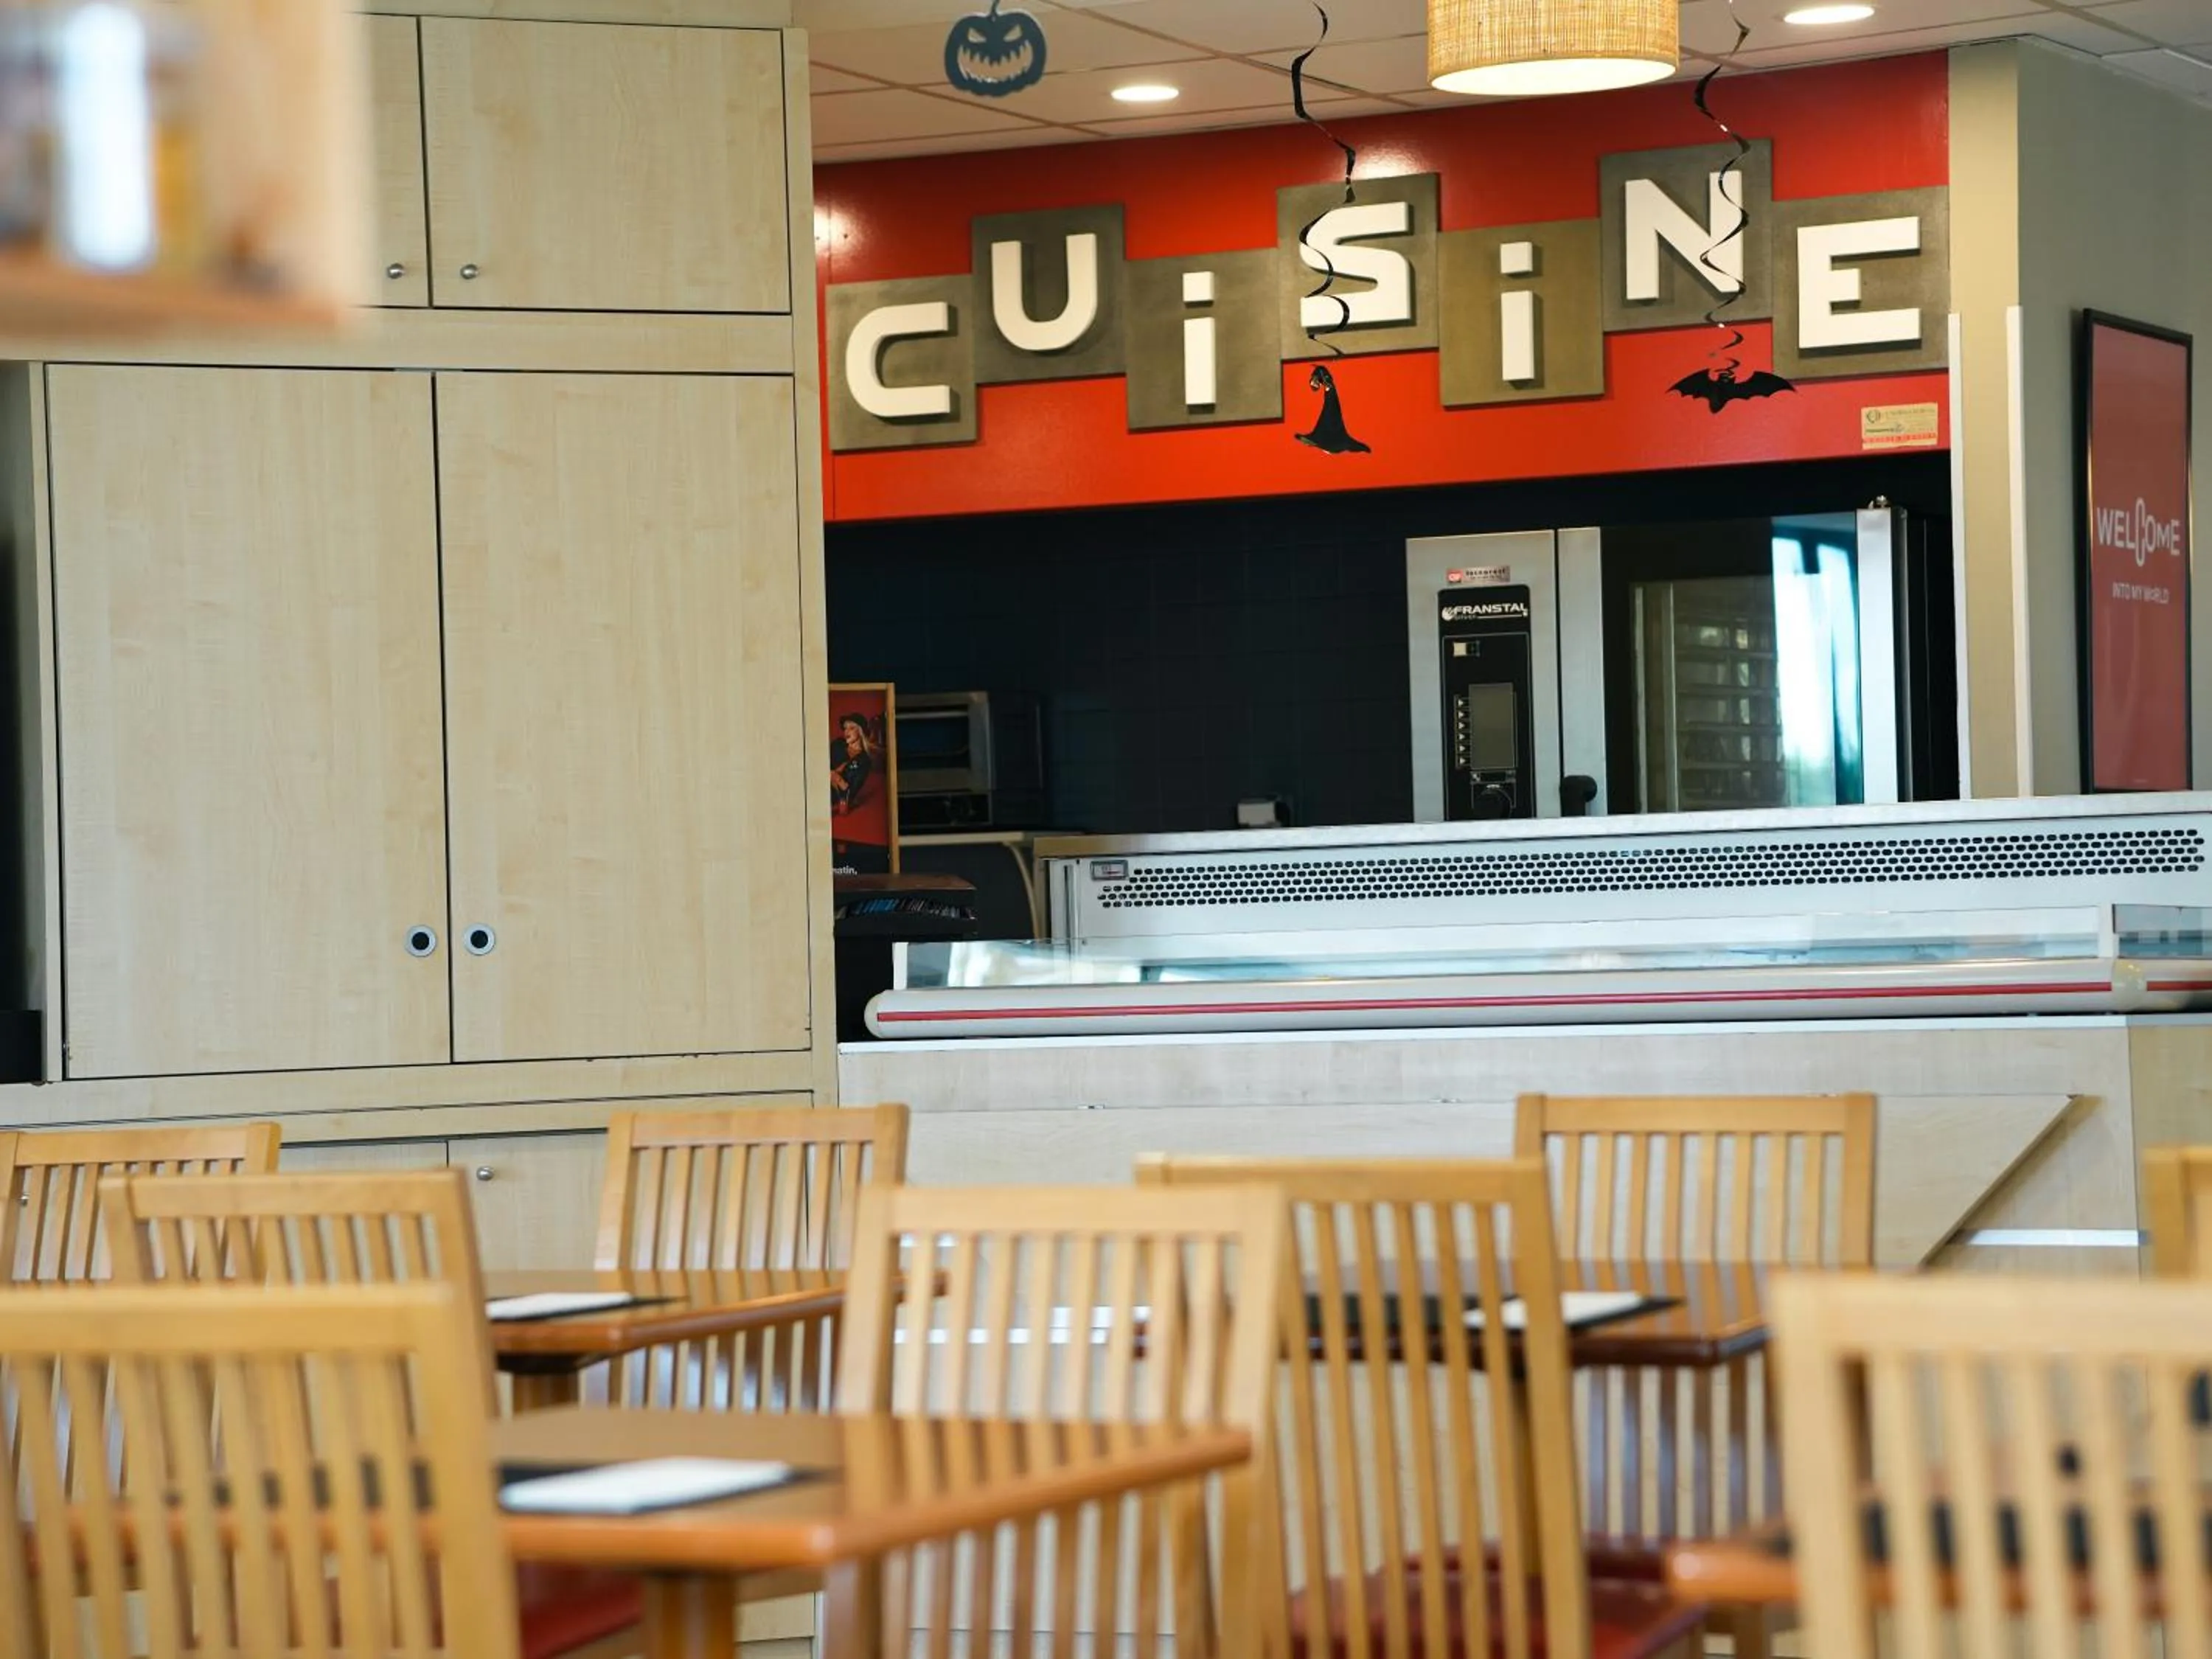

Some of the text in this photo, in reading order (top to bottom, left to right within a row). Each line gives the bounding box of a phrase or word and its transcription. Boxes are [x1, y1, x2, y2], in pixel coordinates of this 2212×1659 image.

[2097, 496, 2180, 567] WELCOME
[2112, 582, 2130, 600] INTO
[1453, 602, 1528, 616] FRANSTAL
